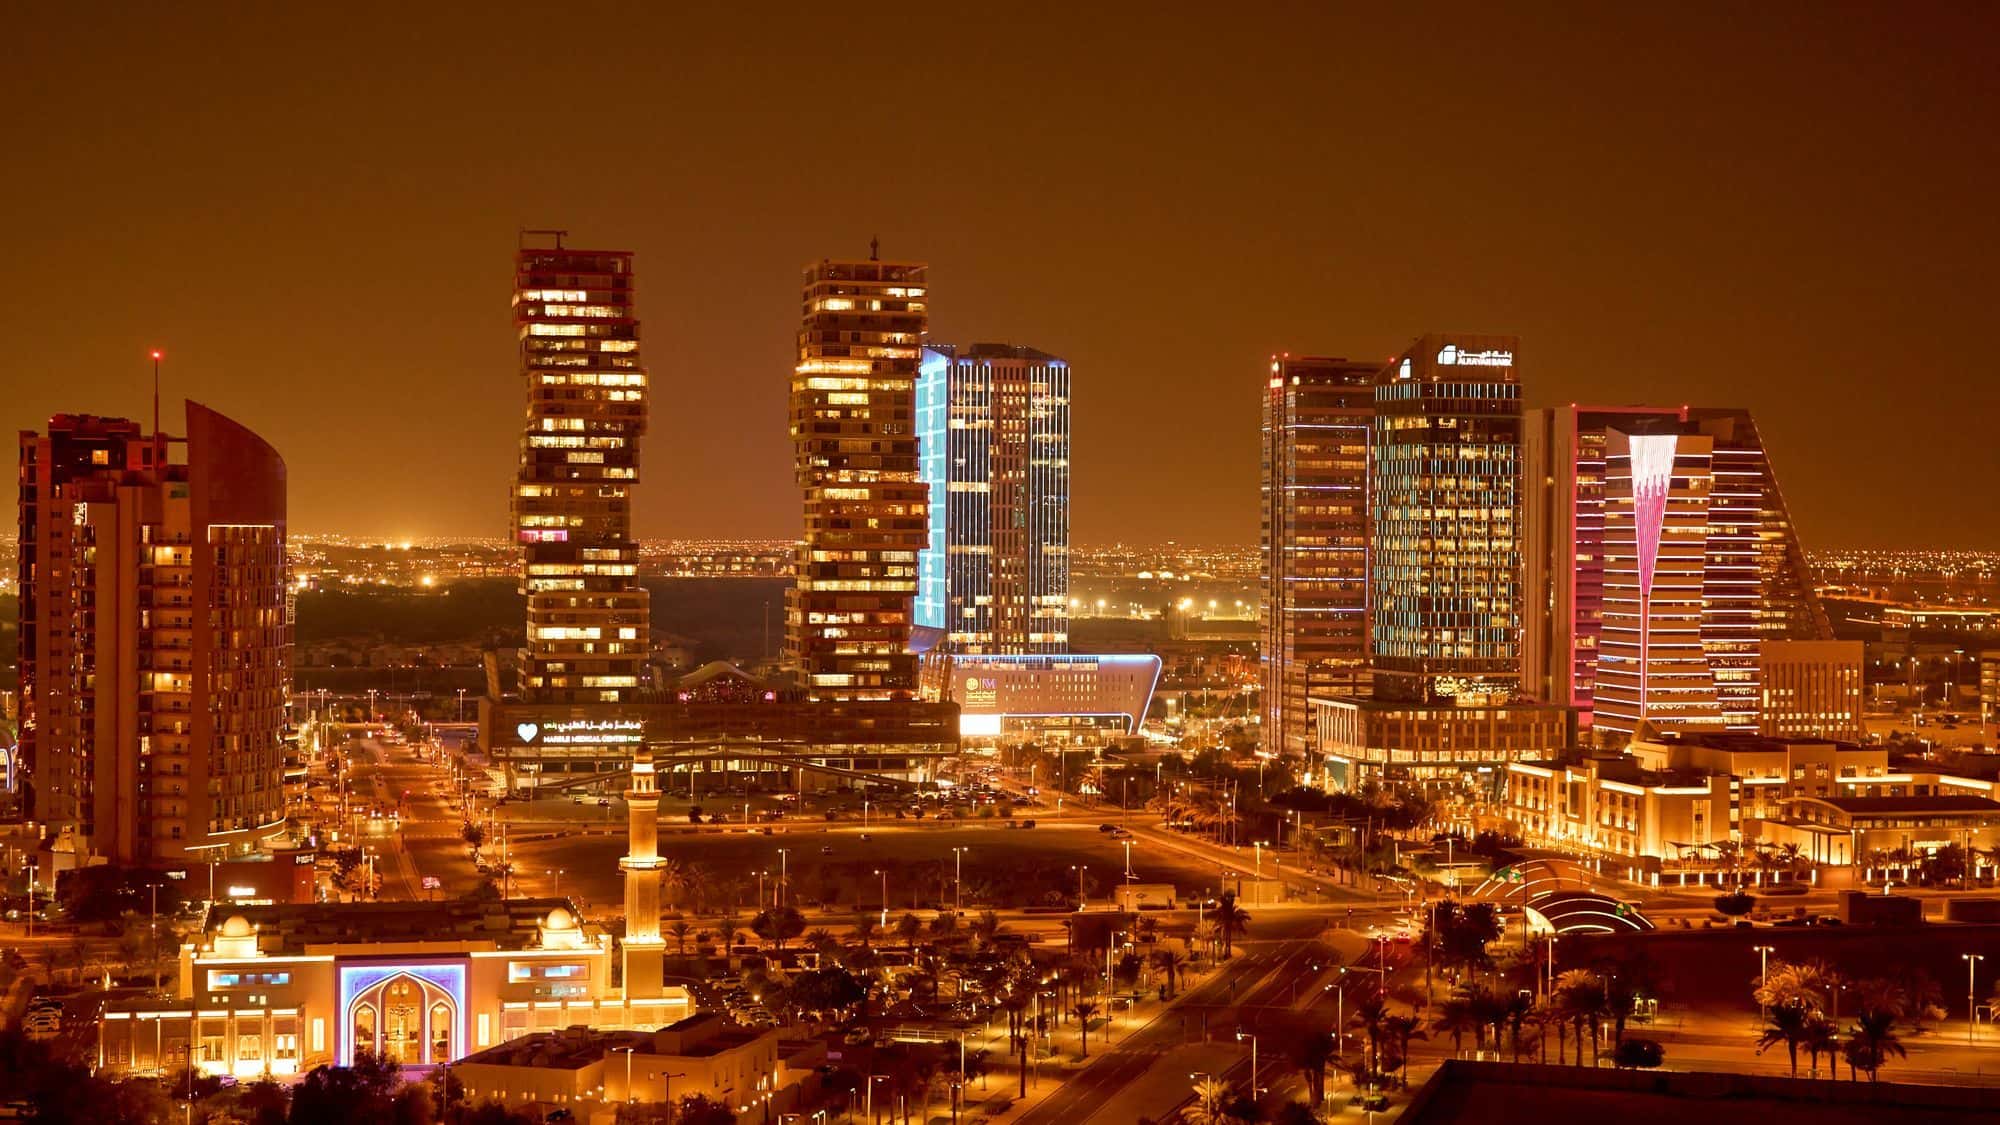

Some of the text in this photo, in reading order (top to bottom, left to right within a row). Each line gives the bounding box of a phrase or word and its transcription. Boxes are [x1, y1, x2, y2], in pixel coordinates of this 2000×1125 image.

[1492, 358, 1512, 366] BANK
[571, 735, 601, 743] MEDICAL
[602, 735, 627, 743] CENTER
